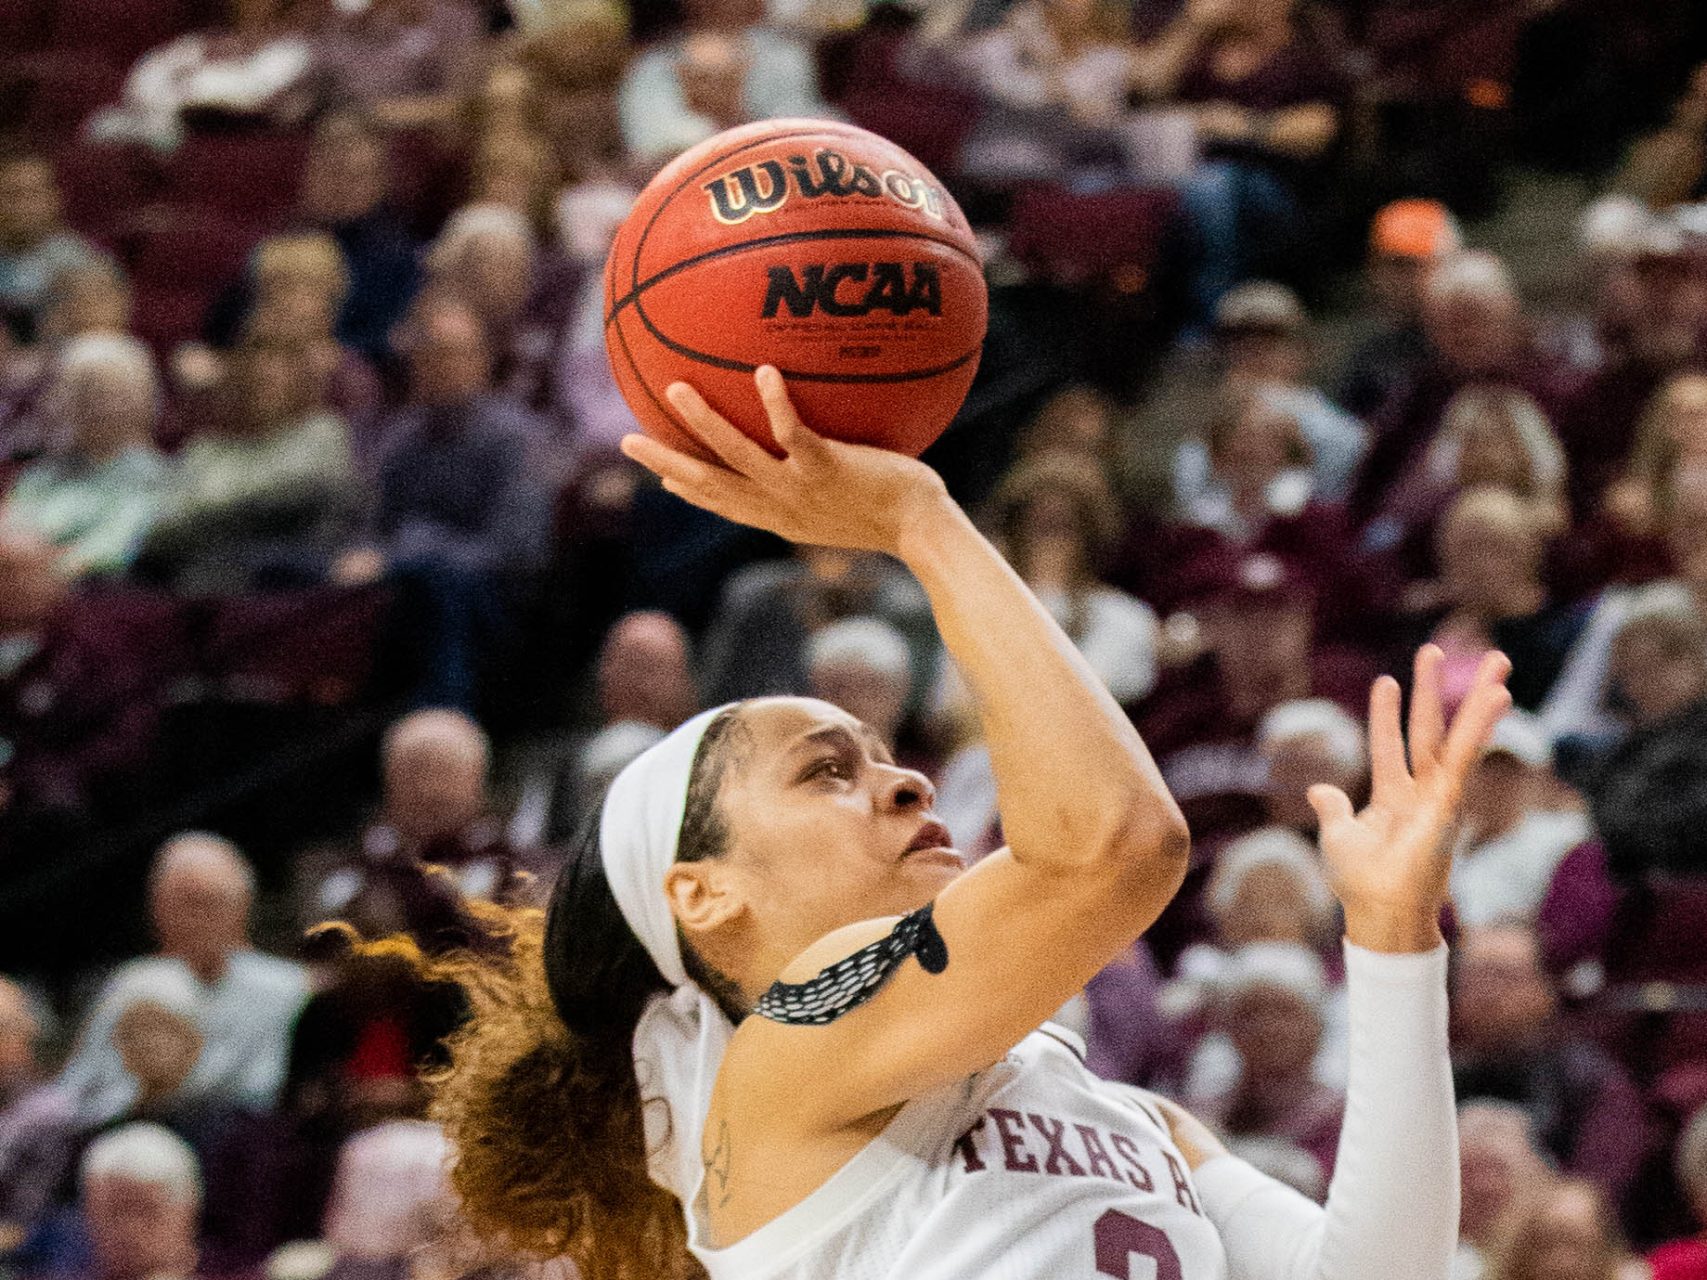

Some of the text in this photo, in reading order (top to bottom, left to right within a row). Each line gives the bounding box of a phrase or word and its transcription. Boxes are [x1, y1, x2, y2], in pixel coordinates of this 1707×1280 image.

[701, 147, 943, 226] Wilson
[761, 261, 944, 319] NCAA
[952, 1107, 1155, 1194] TEXAS
